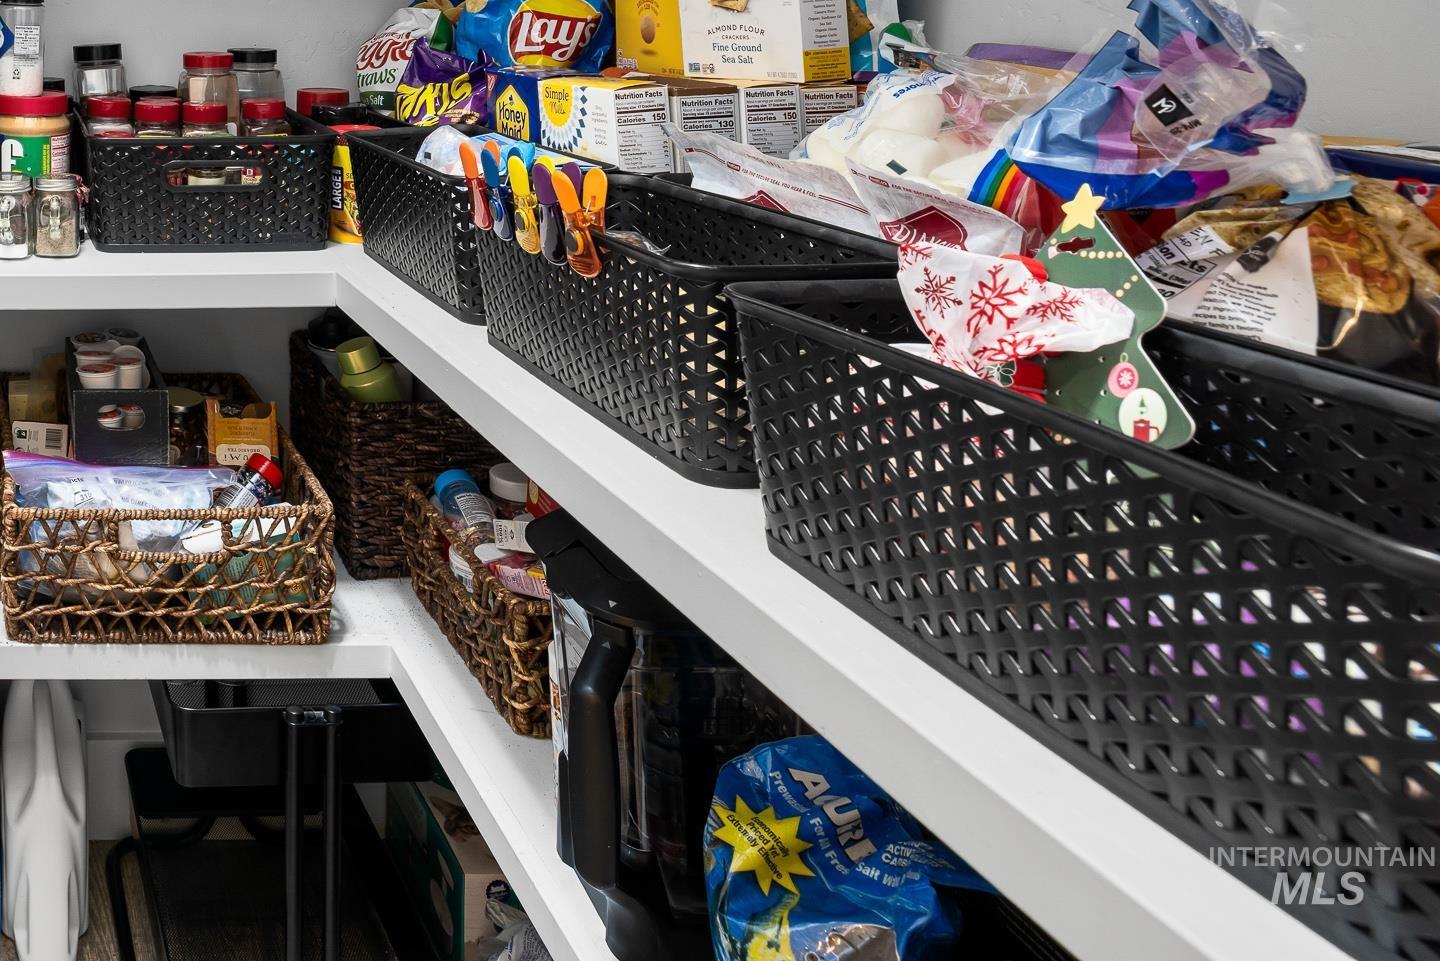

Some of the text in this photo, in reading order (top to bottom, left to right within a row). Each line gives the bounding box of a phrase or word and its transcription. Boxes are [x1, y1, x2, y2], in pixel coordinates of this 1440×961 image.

[707, 24, 765, 37] ALMOND FLOUR
[514, 12, 597, 62] Lay's
[712, 42, 763, 53] Fine Ground
[721, 55, 755, 66] Sea Salt
[544, 85, 570, 103] Simple
[614, 89, 663, 101] Nutrition Facts
[745, 89, 795, 99] Nutrition Facts
[804, 91, 854, 101] Nutrition Facts
[369, 94, 385, 107] Salt
[681, 98, 734, 108] Nutrition Facts
[498, 102, 527, 130] Honey
[617, 112, 666, 124] Calories 150
[747, 112, 797, 123] Calories 150
[682, 119, 735, 130] Calories 130
[781, 181, 791, 190] YOU
[332, 175, 342, 210] LARGE
[745, 820, 781, 860] Priced Yet
[750, 815, 791, 859] Economically
[725, 813, 784, 881] Extremely Effective
[810, 816, 824, 840] For
[855, 861, 880, 882] Salt
